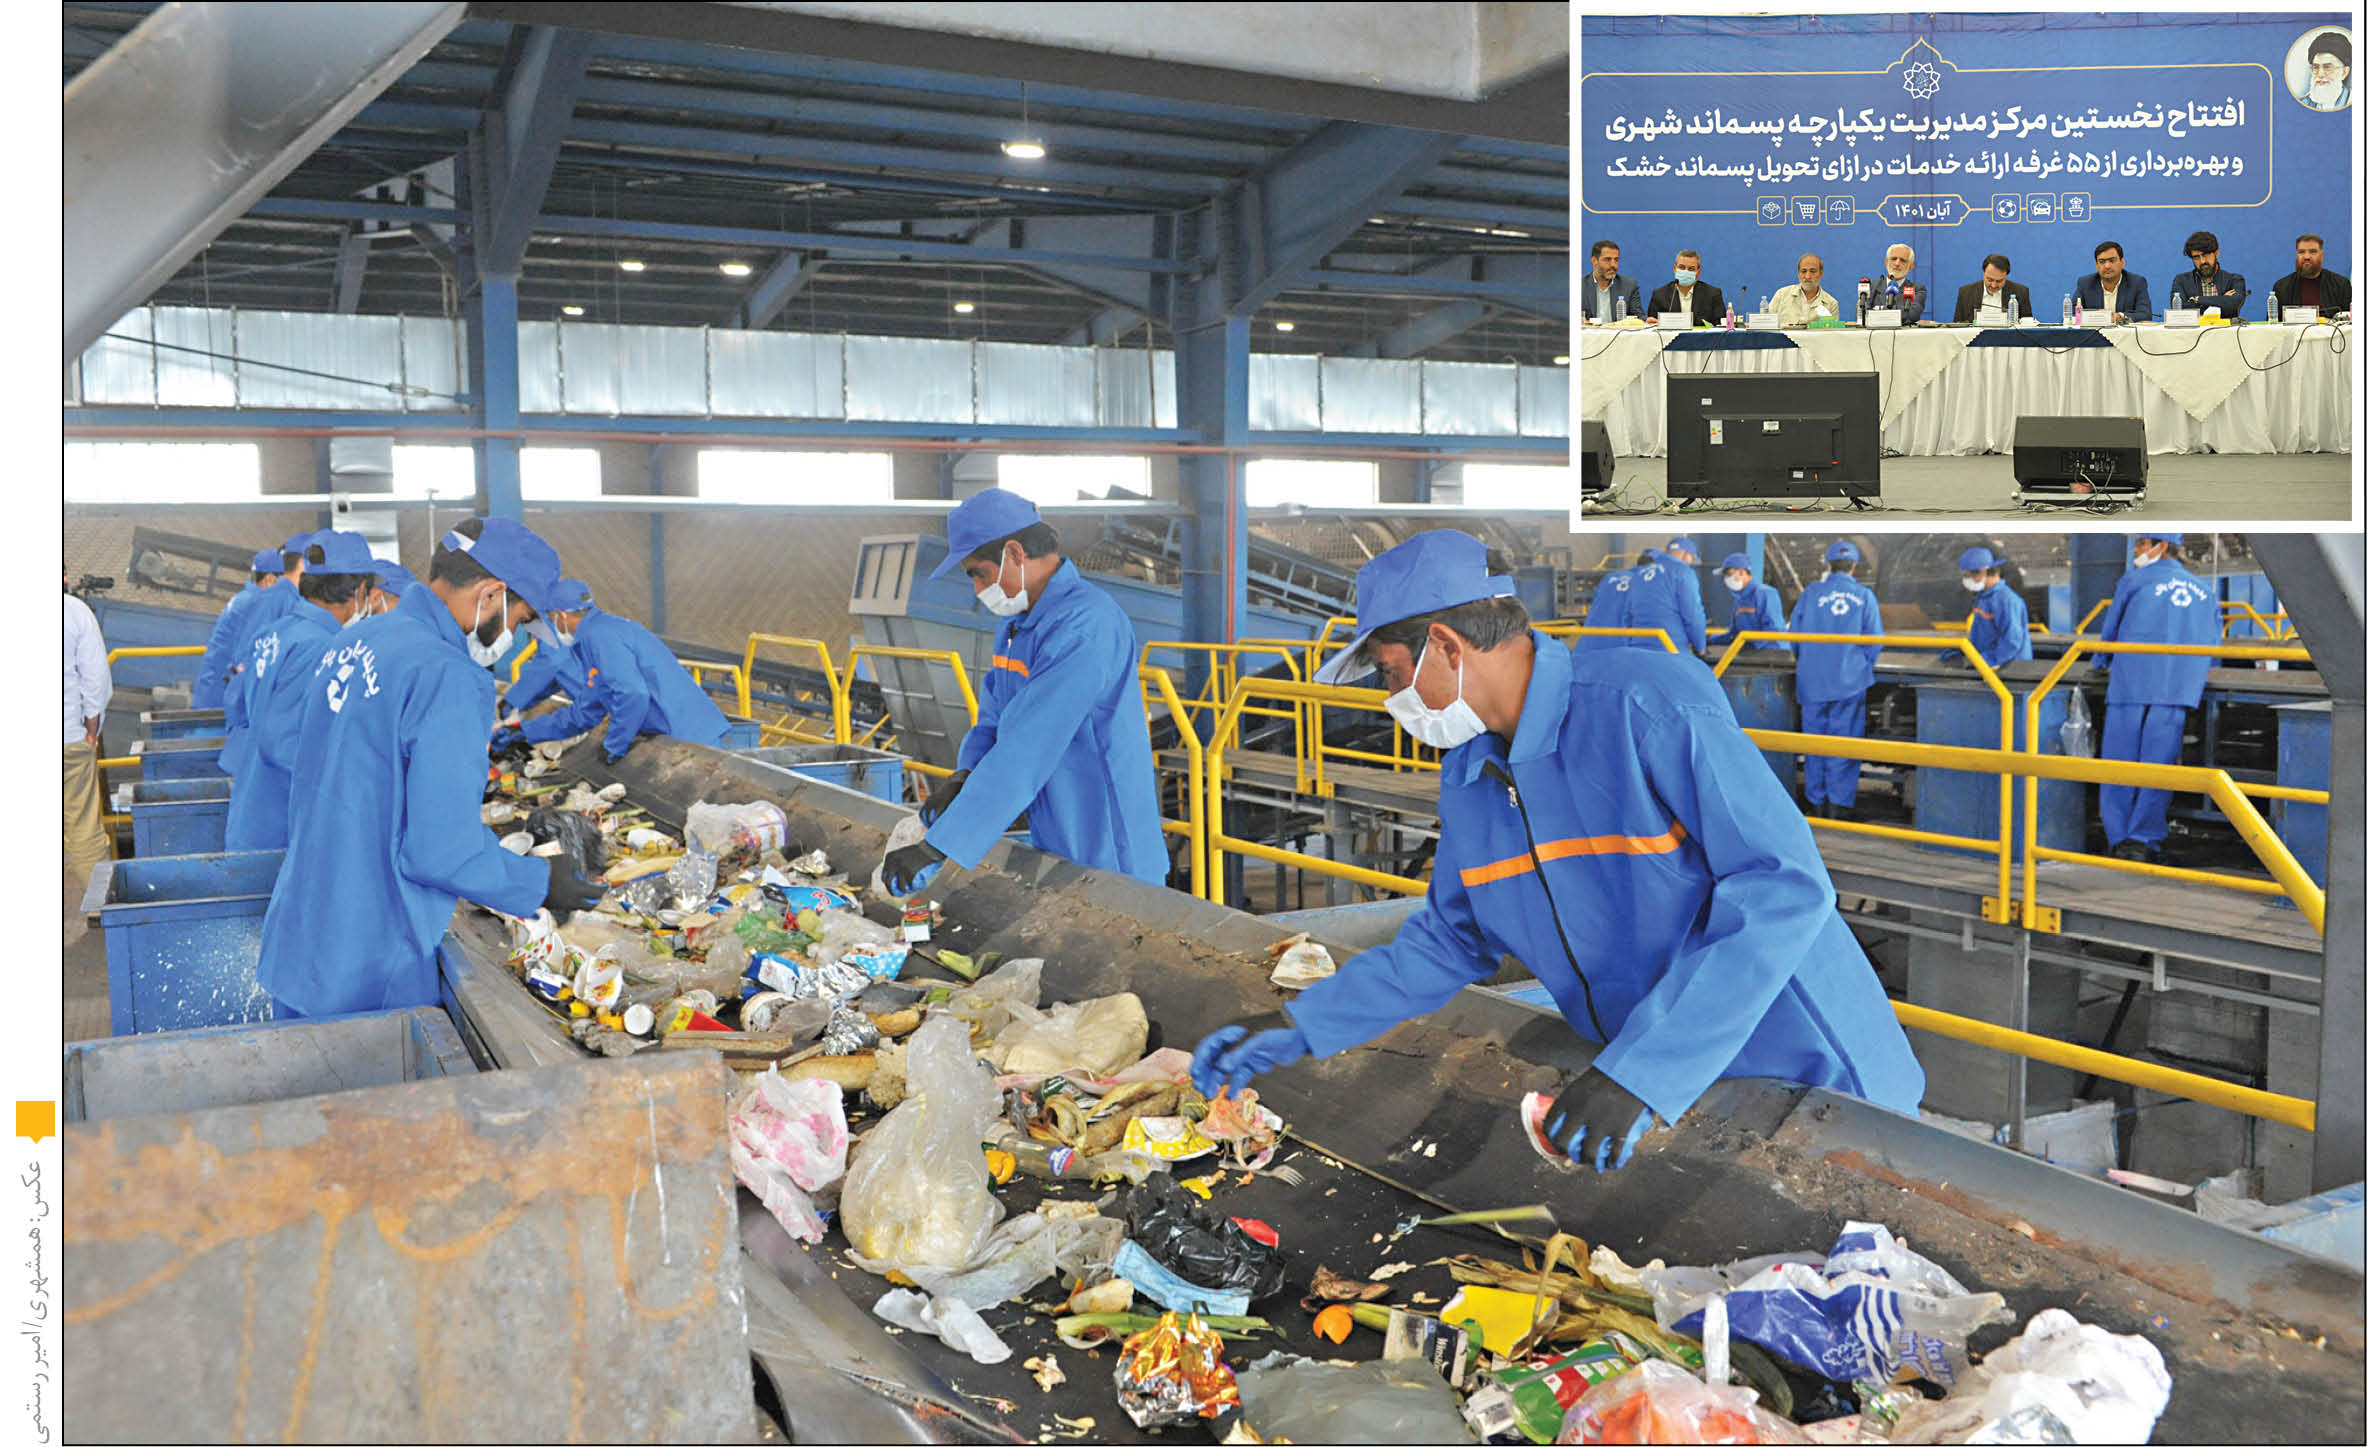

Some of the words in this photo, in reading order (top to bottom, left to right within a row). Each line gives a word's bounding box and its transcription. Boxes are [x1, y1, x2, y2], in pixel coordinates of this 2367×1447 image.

[1605, 108, 1683, 143] شهری
[1686, 108, 1785, 148] پسماند
[1788, 107, 1887, 148] یکپارچه
[1889, 111, 1987, 142] مدیریت
[1987, 106, 2048, 140] مرکز
[2051, 102, 2165, 139] نخستین
[2168, 97, 2245, 138] افتتاح
[1606, 155, 1672, 177] خشک
[1674, 155, 1755, 187] پسماند
[1757, 155, 1820, 183] تحویل
[1822, 154, 1860, 182] ازای
[1860, 158, 1885, 182] در
[1887, 154, 1962, 176] خدمات
[1964, 151, 2010, 180] ارائه
[2012, 148, 2064, 179] غرفه
[2067, 151, 2101, 174] ۵۵
[2101, 149, 2117, 178] از
[2231, 156, 2244, 177] و
[1895, 204, 1924, 218] ۱۴۰۱
[1926, 200, 1952, 221] آبان
